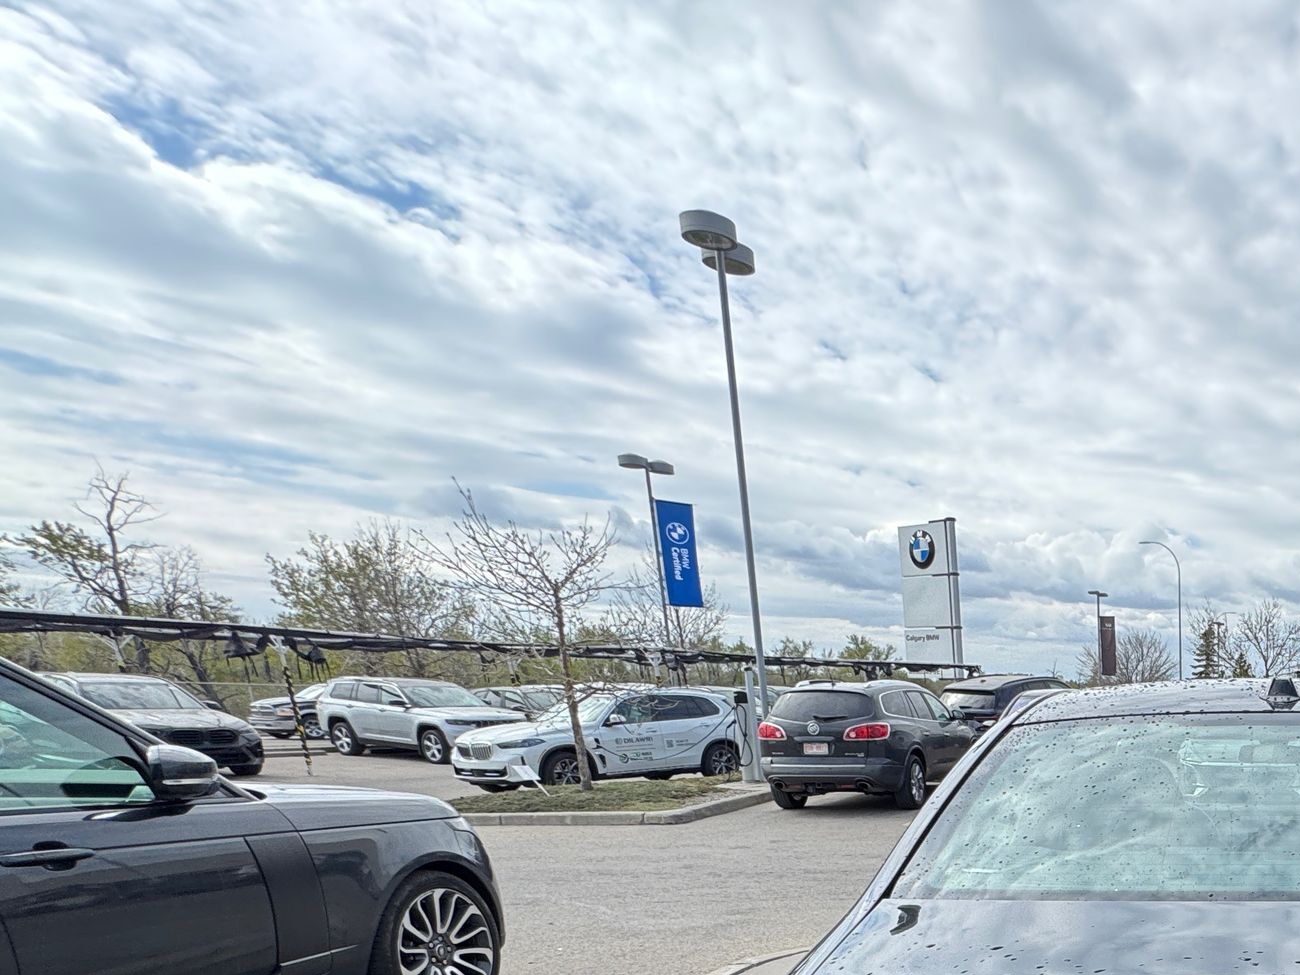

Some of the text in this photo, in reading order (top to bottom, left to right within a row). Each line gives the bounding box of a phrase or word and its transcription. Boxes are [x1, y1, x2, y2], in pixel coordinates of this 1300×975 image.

[671, 547, 684, 581] Certified
[680, 547, 691, 570] BMW
[905, 634, 925, 643] Calgary
